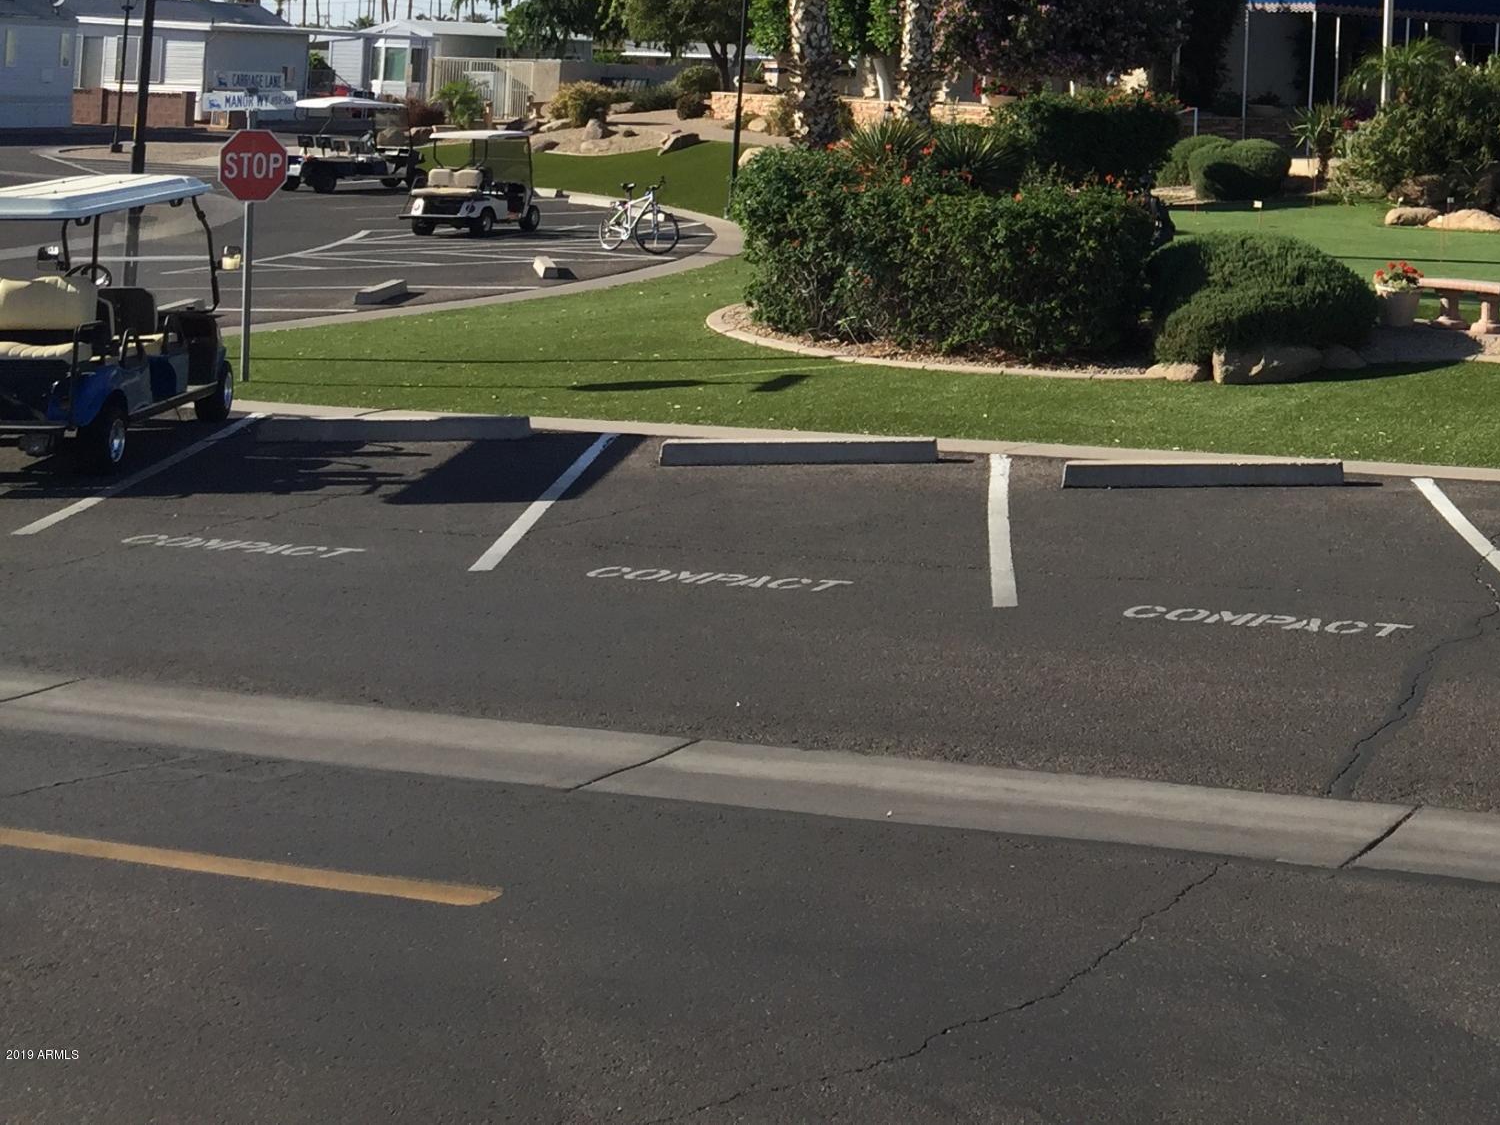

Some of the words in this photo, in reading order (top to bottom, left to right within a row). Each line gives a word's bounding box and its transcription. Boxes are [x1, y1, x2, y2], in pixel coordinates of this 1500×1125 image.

[224, 95, 253, 107] MANOR
[224, 152, 283, 179] STOP
[121, 534, 366, 558] COMPACT
[586, 566, 854, 592] COMPACT
[1122, 605, 1415, 637] COMPACT
